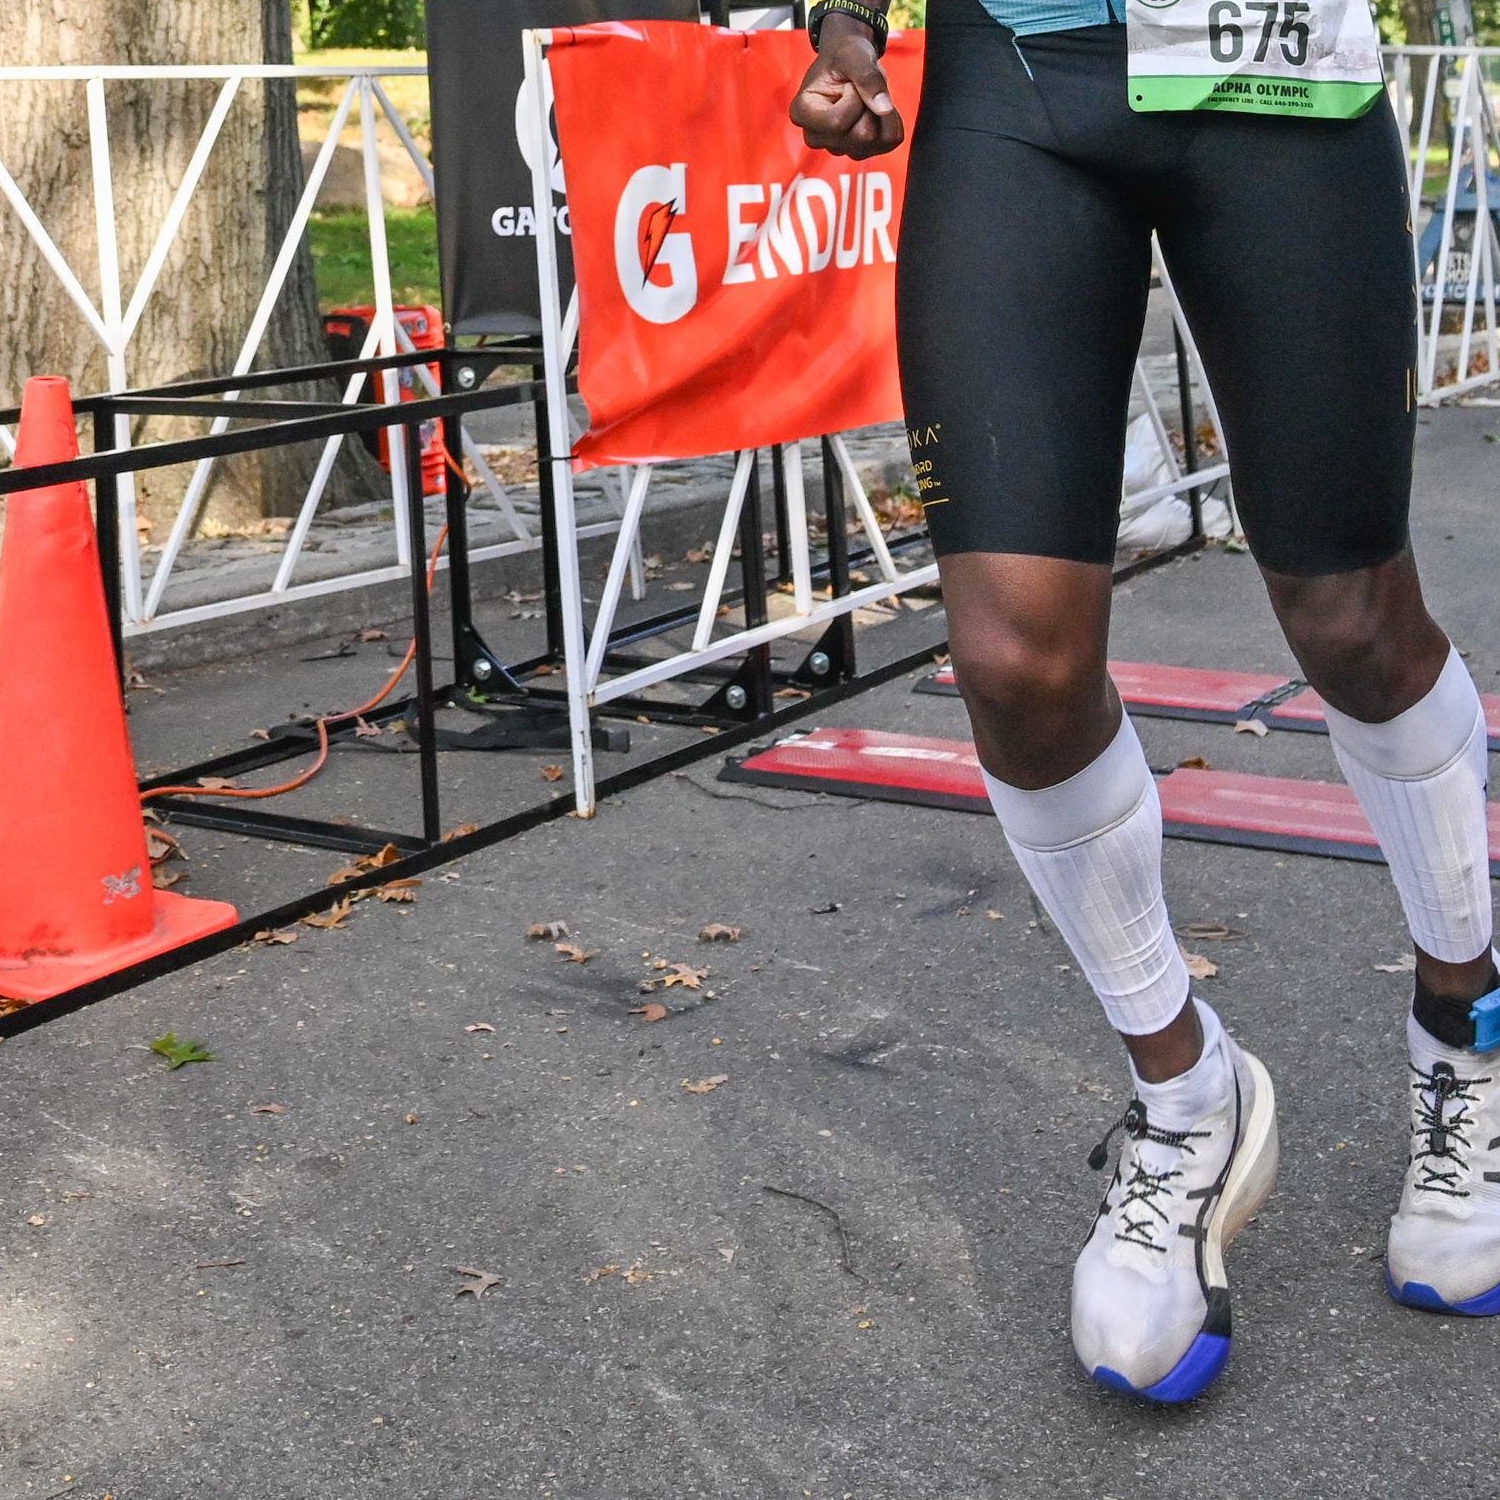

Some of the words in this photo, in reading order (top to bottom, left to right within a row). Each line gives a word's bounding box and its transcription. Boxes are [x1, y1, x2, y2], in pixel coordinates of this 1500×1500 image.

[1207, 0, 1310, 68] 675
[1213, 82, 1252, 94] ALPHA
[1256, 83, 1309, 98] OLYMPIC
